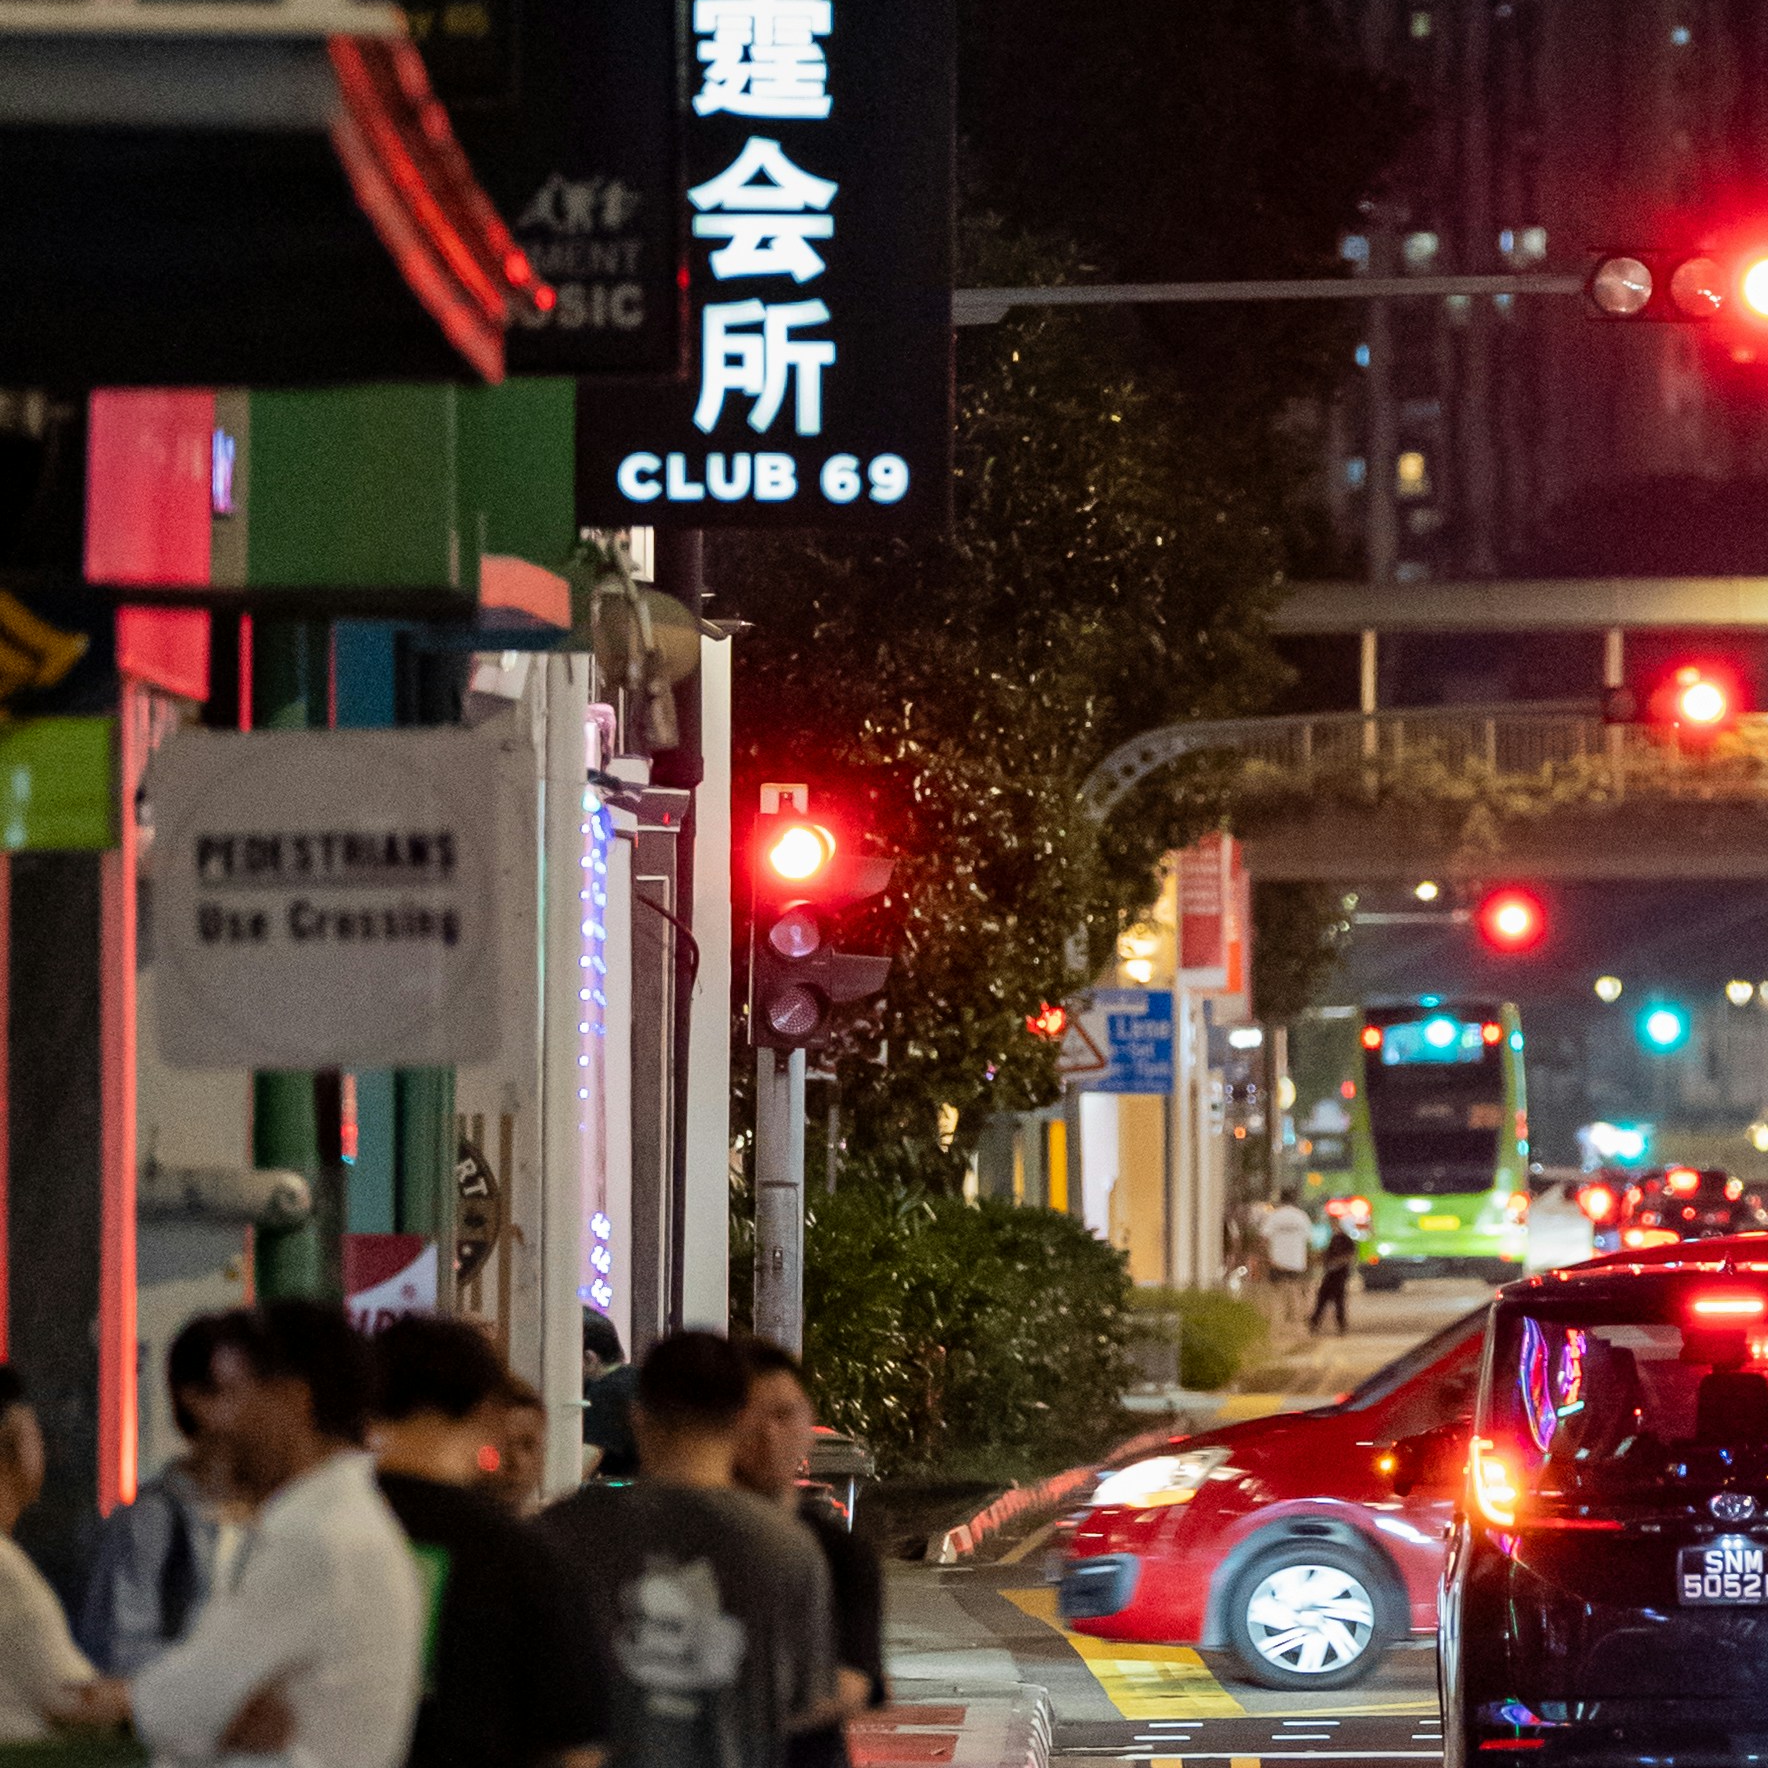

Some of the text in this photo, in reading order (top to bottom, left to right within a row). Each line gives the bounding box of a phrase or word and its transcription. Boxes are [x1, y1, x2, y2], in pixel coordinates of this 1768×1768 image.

[617, 453, 910, 503] CLUB 69
[196, 833, 457, 880] PEDESTRIANS
[197, 899, 460, 948] Use Crossing
[1704, 1549, 1764, 1575] SNM
